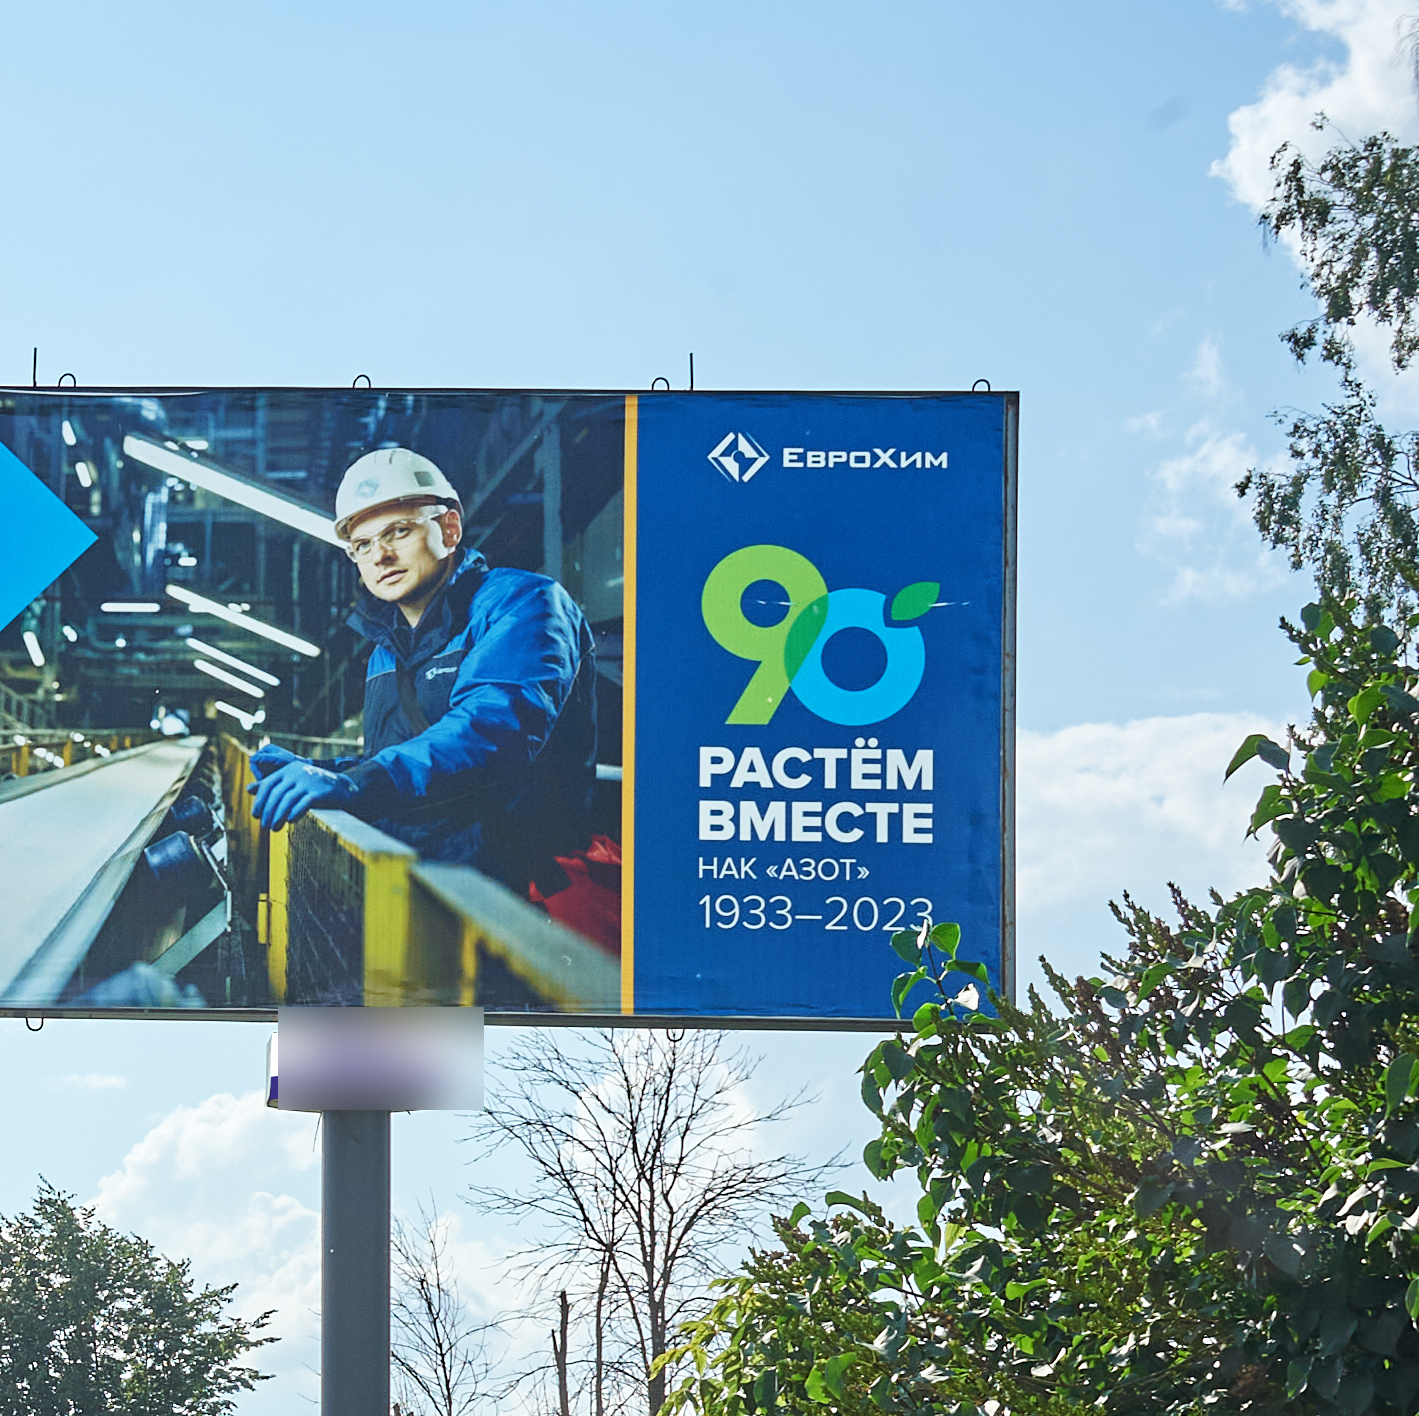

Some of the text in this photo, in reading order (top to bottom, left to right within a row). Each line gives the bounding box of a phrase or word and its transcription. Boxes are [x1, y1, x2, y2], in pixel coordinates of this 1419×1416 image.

[701, 544, 926, 726] 90
[699, 737, 934, 791] РАСТЁМ
[698, 800, 934, 844] ВМЕСТЕ
[698, 857, 870, 880] НАК «АЗОТ»
